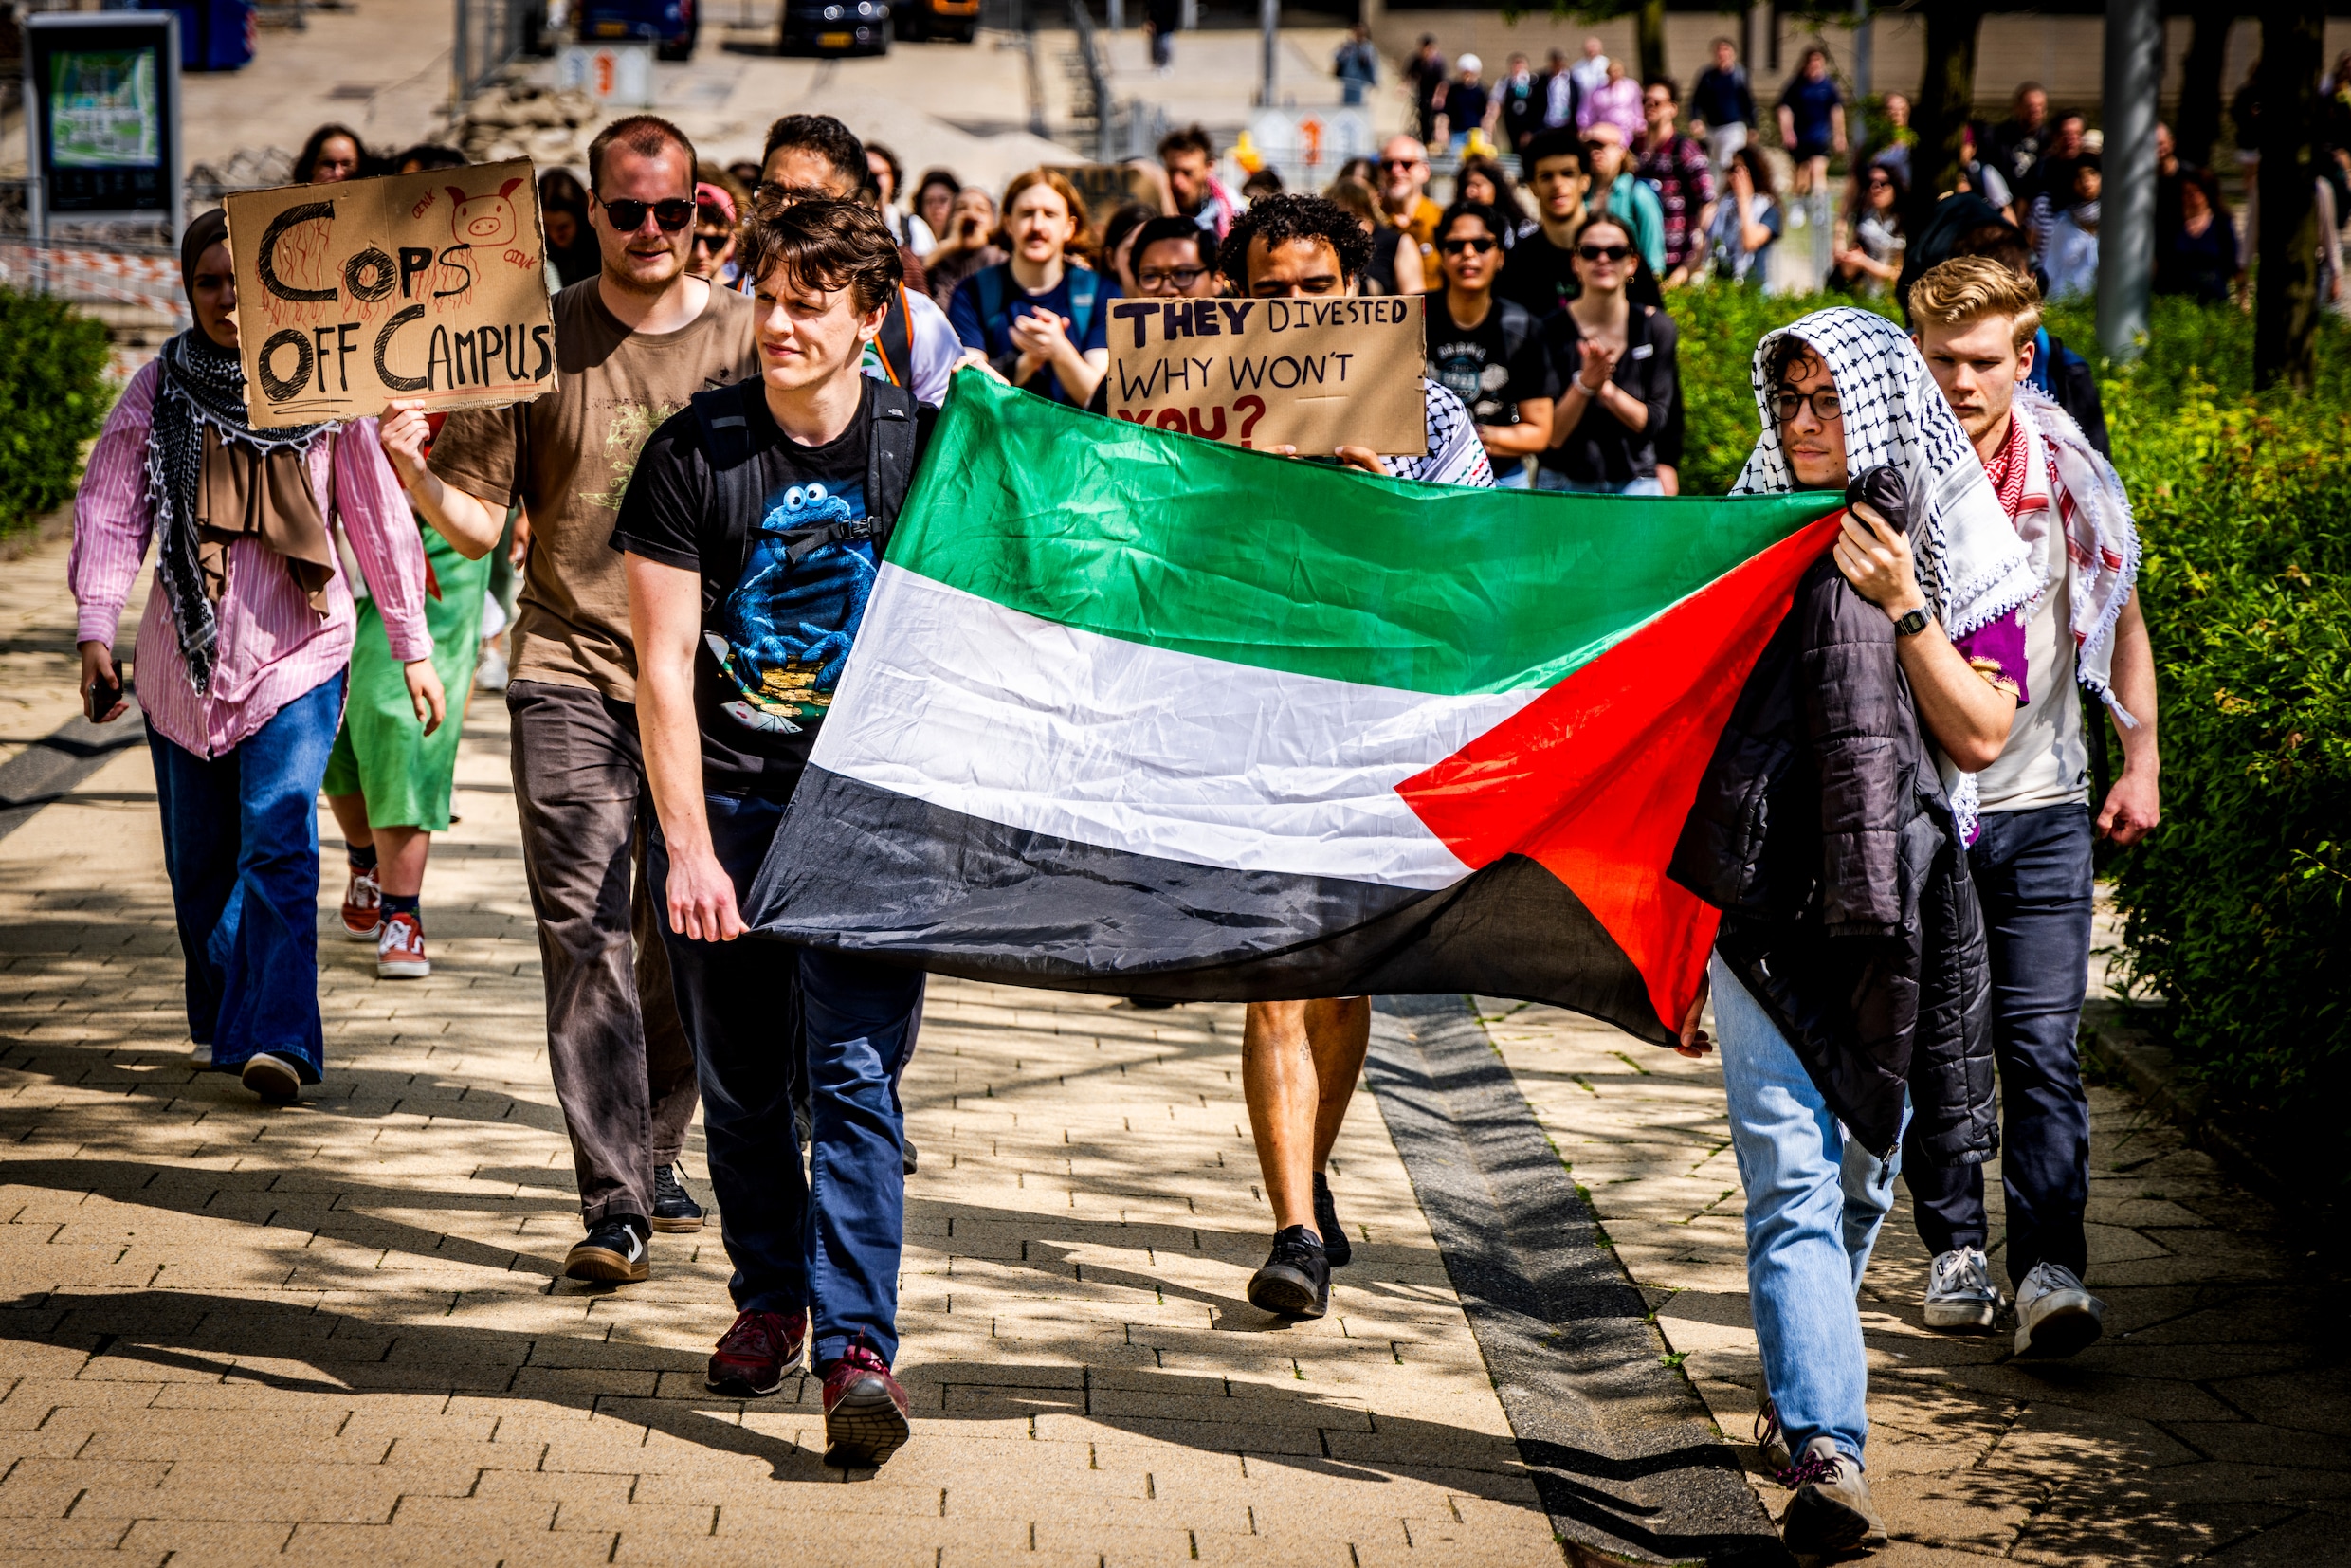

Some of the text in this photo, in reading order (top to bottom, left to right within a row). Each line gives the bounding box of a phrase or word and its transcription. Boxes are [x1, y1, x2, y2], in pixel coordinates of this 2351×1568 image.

[411, 187, 436, 220] OINK
[258, 199, 471, 303] COPS
[503, 248, 537, 270] OINK
[1113, 299, 1408, 349] THEY DIVESTED
[258, 303, 553, 402] OFF CAMPUS
[1118, 351, 1354, 402] WHY WON'T
